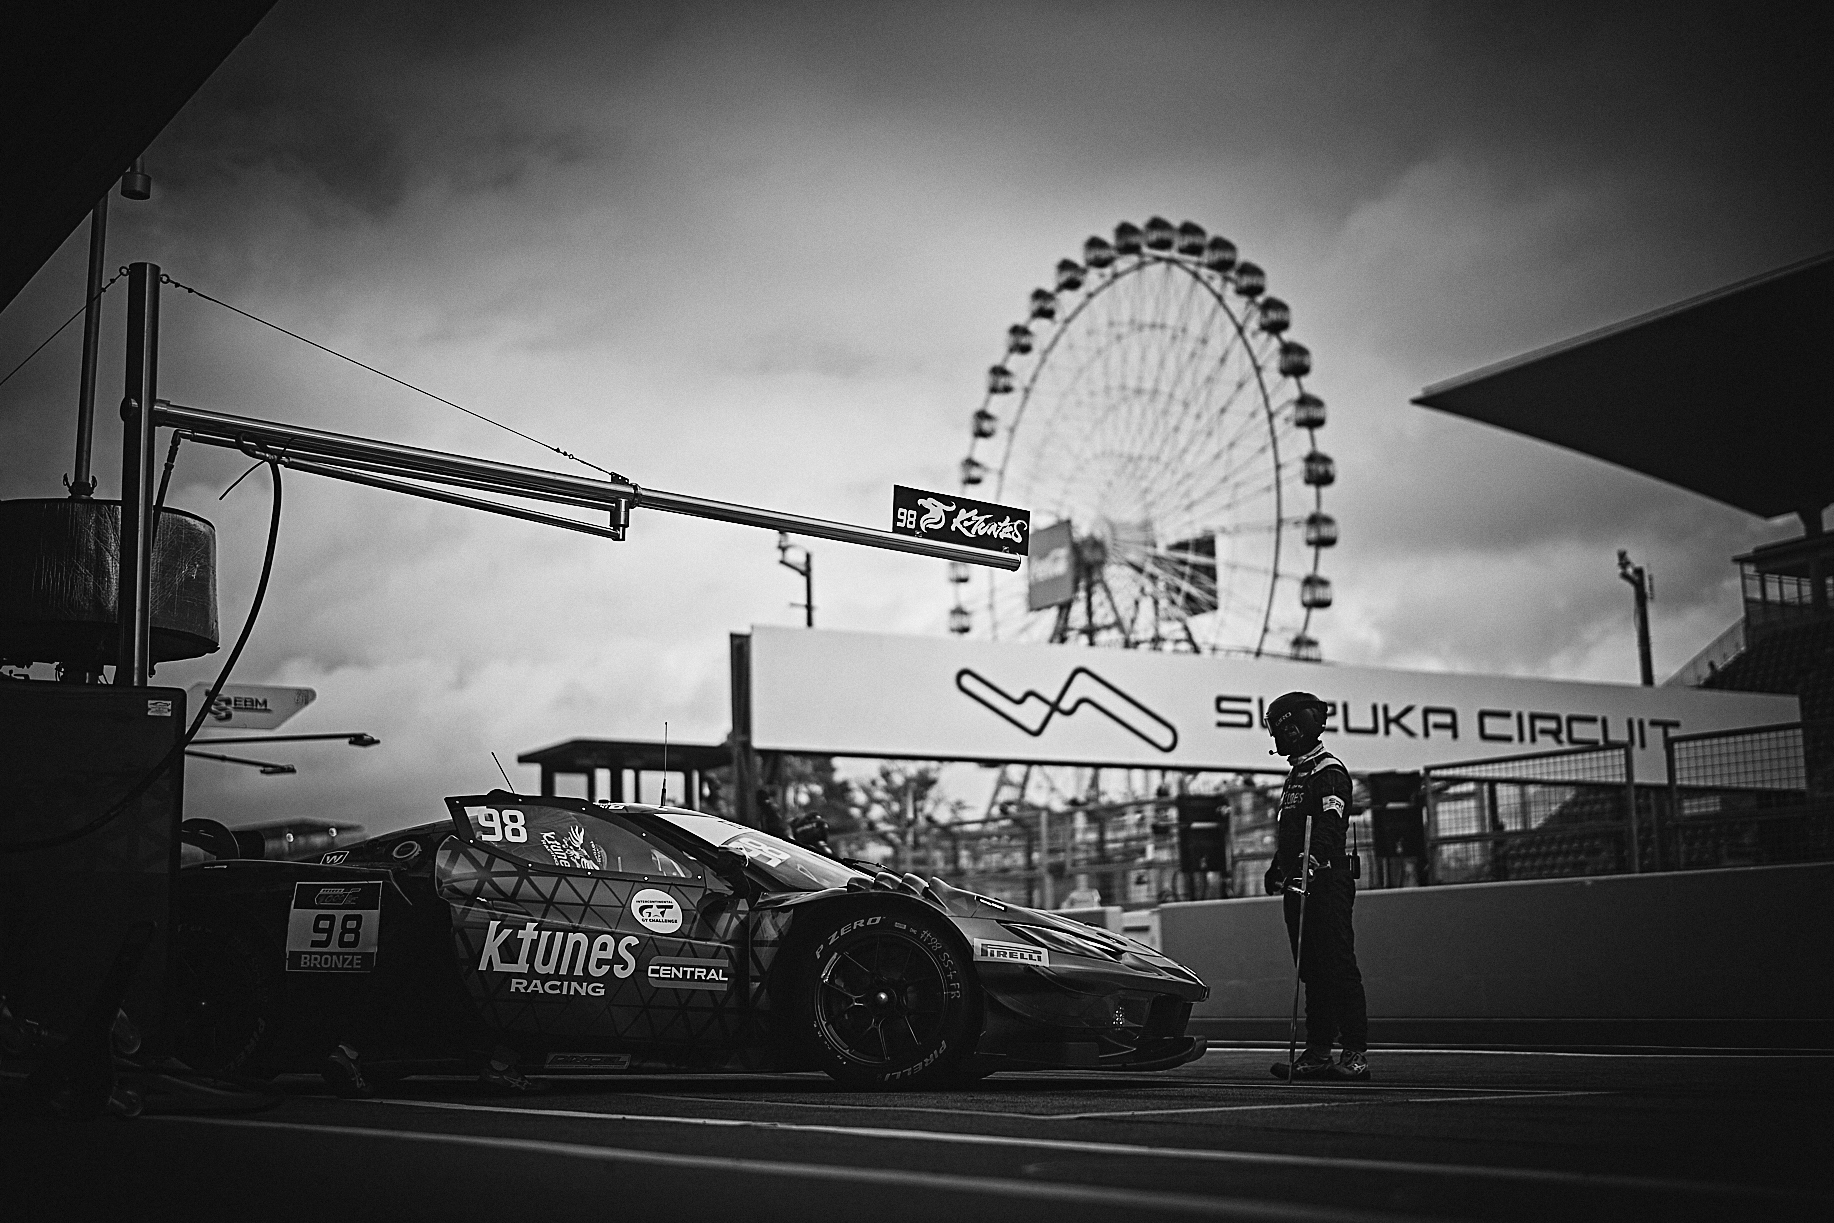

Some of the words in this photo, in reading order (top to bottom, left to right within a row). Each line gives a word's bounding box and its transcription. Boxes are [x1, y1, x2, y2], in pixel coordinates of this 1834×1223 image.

[896, 508, 917, 529] 98
[1478, 709, 1681, 749] CIRCUIT
[477, 807, 528, 843] 98
[310, 913, 363, 949] 98
[827, 916, 882, 946] ZERO
[920, 929, 942, 951] #98
[300, 954, 362, 969] BRONZE
[478, 920, 640, 978] ktunes
[980, 943, 1043, 963] PIRELLI
[647, 965, 729, 981] CENTRAL
[510, 978, 606, 997] RACING
[884, 1040, 948, 1082] PIRELLI
